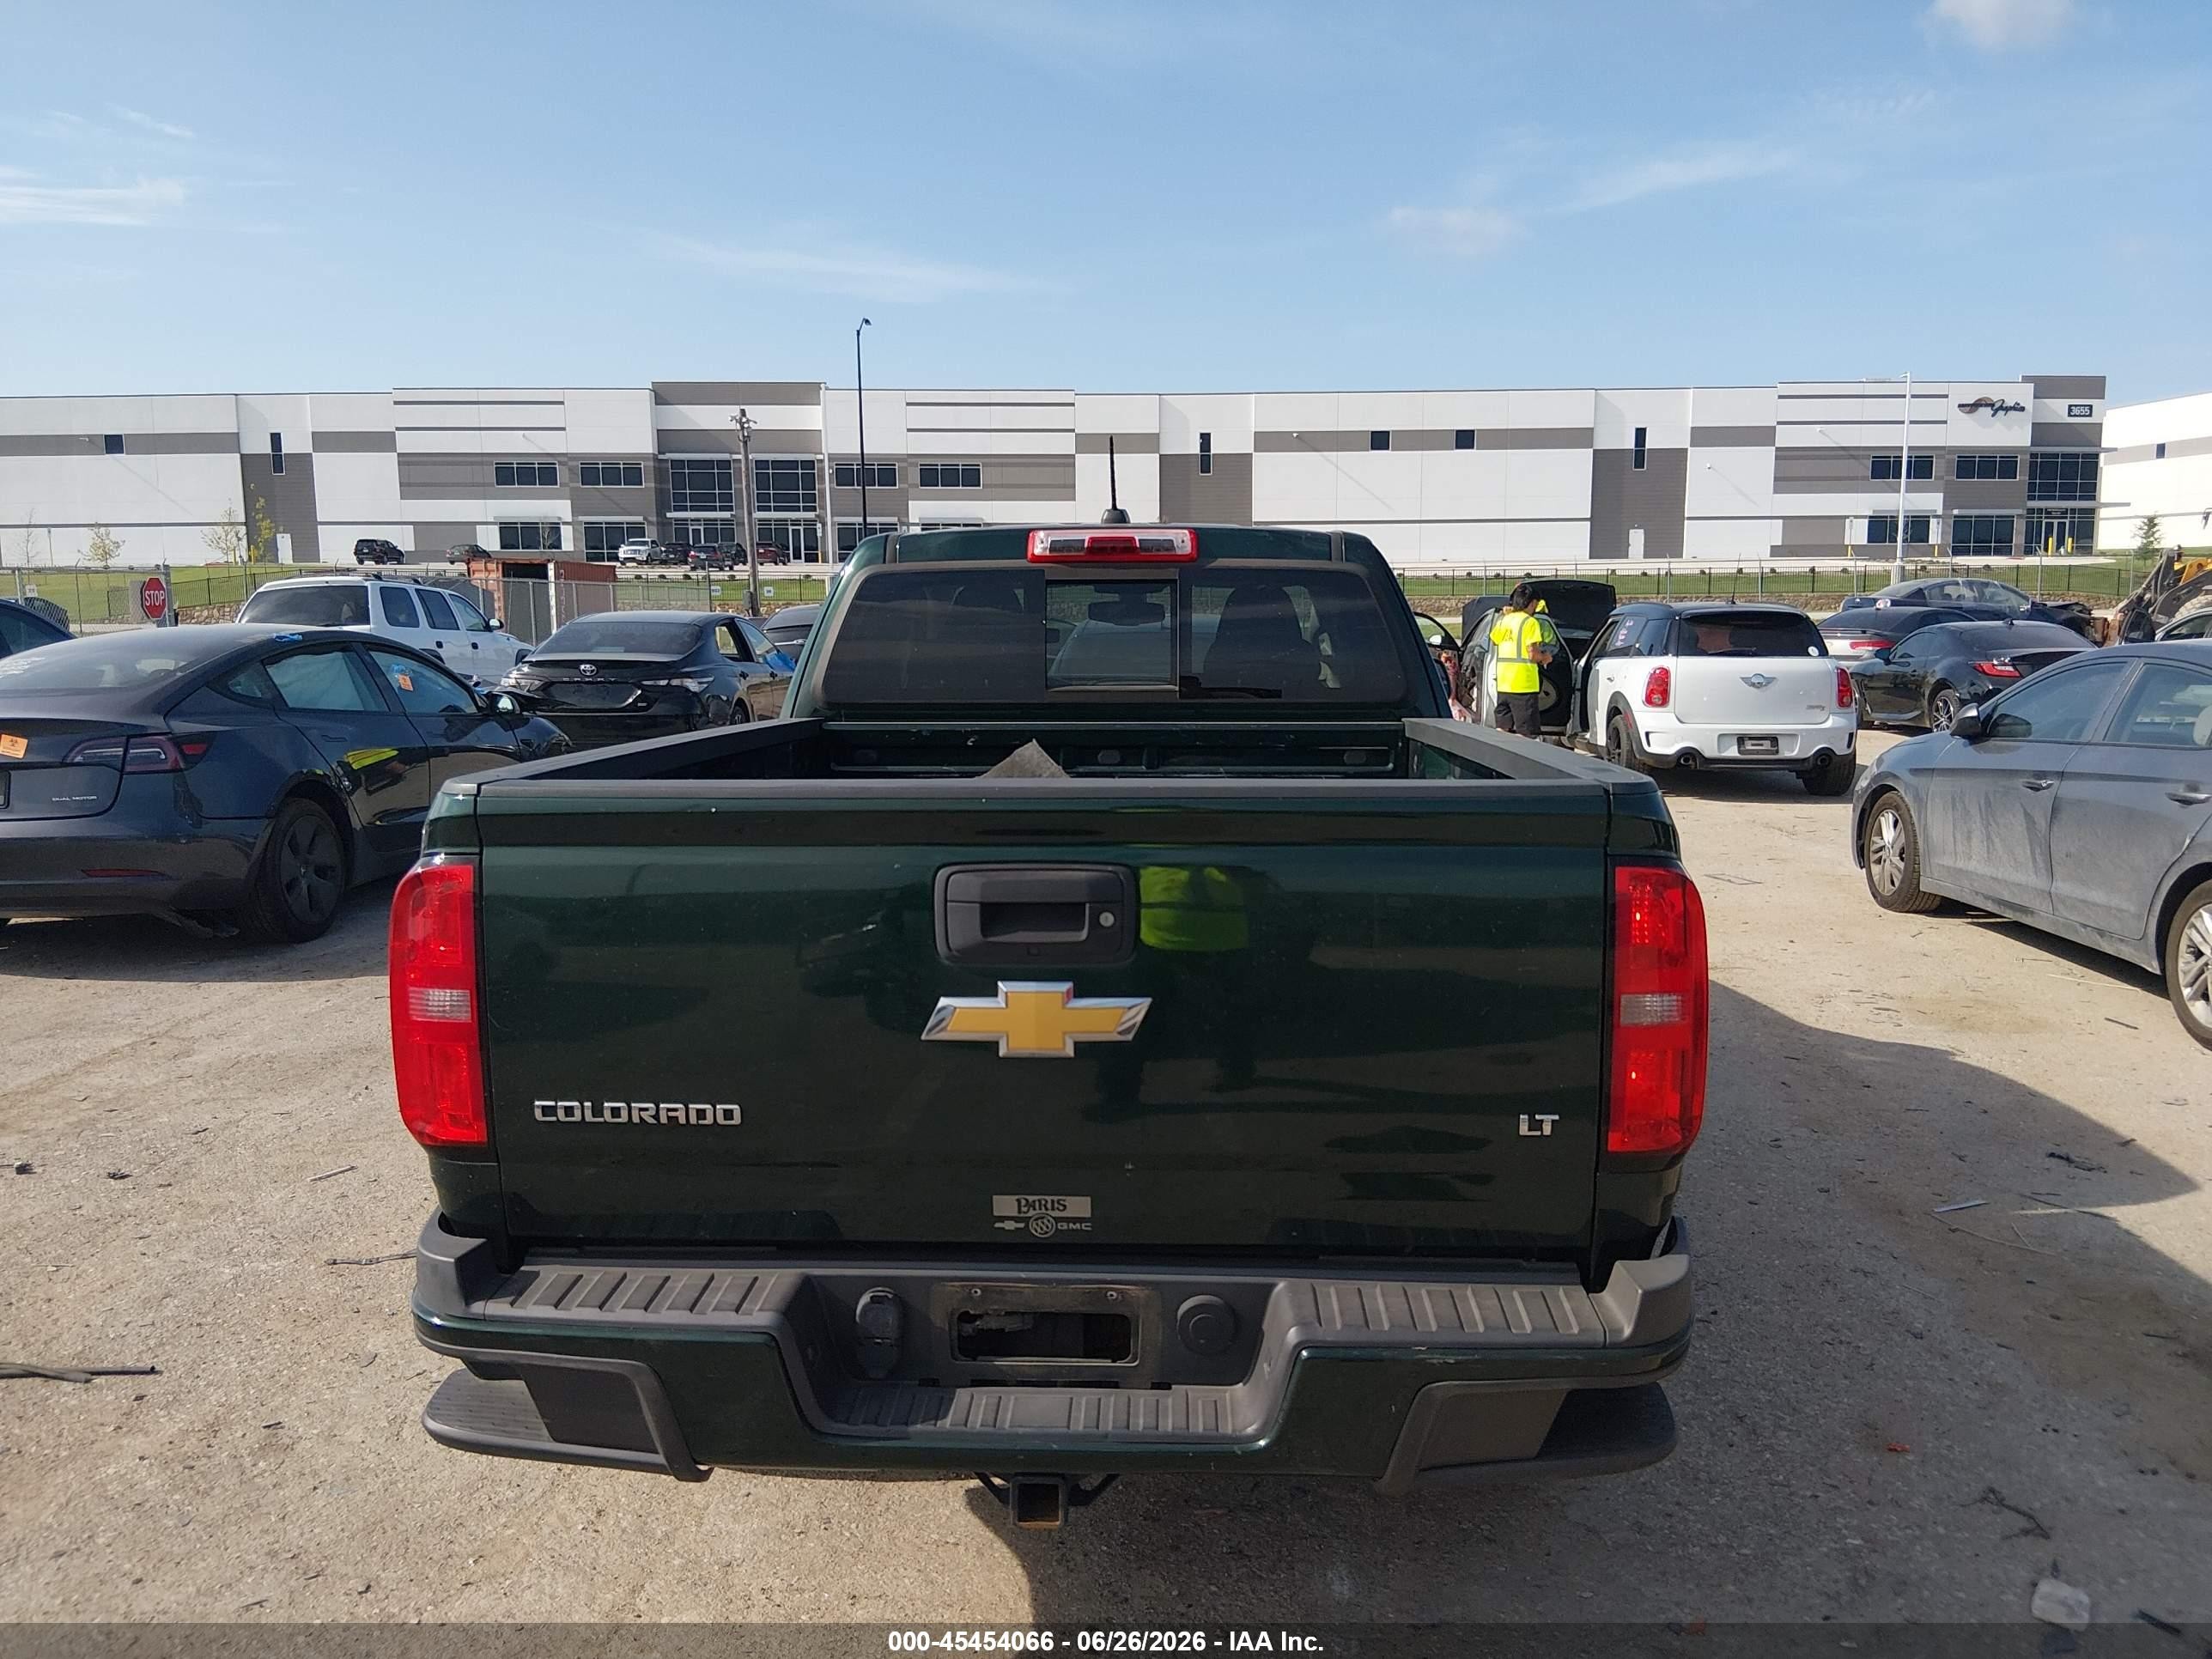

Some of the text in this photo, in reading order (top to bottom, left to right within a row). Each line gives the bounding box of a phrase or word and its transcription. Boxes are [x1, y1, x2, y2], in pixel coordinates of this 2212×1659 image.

[2069, 406, 2090, 416] 3655
[145, 590, 165, 606] STOP
[534, 1101, 742, 1126] COLORADO
[1519, 1114, 1559, 1136] LT
[1015, 1197, 1067, 1215] PARIS
[1057, 1222, 1092, 1231] GMC
